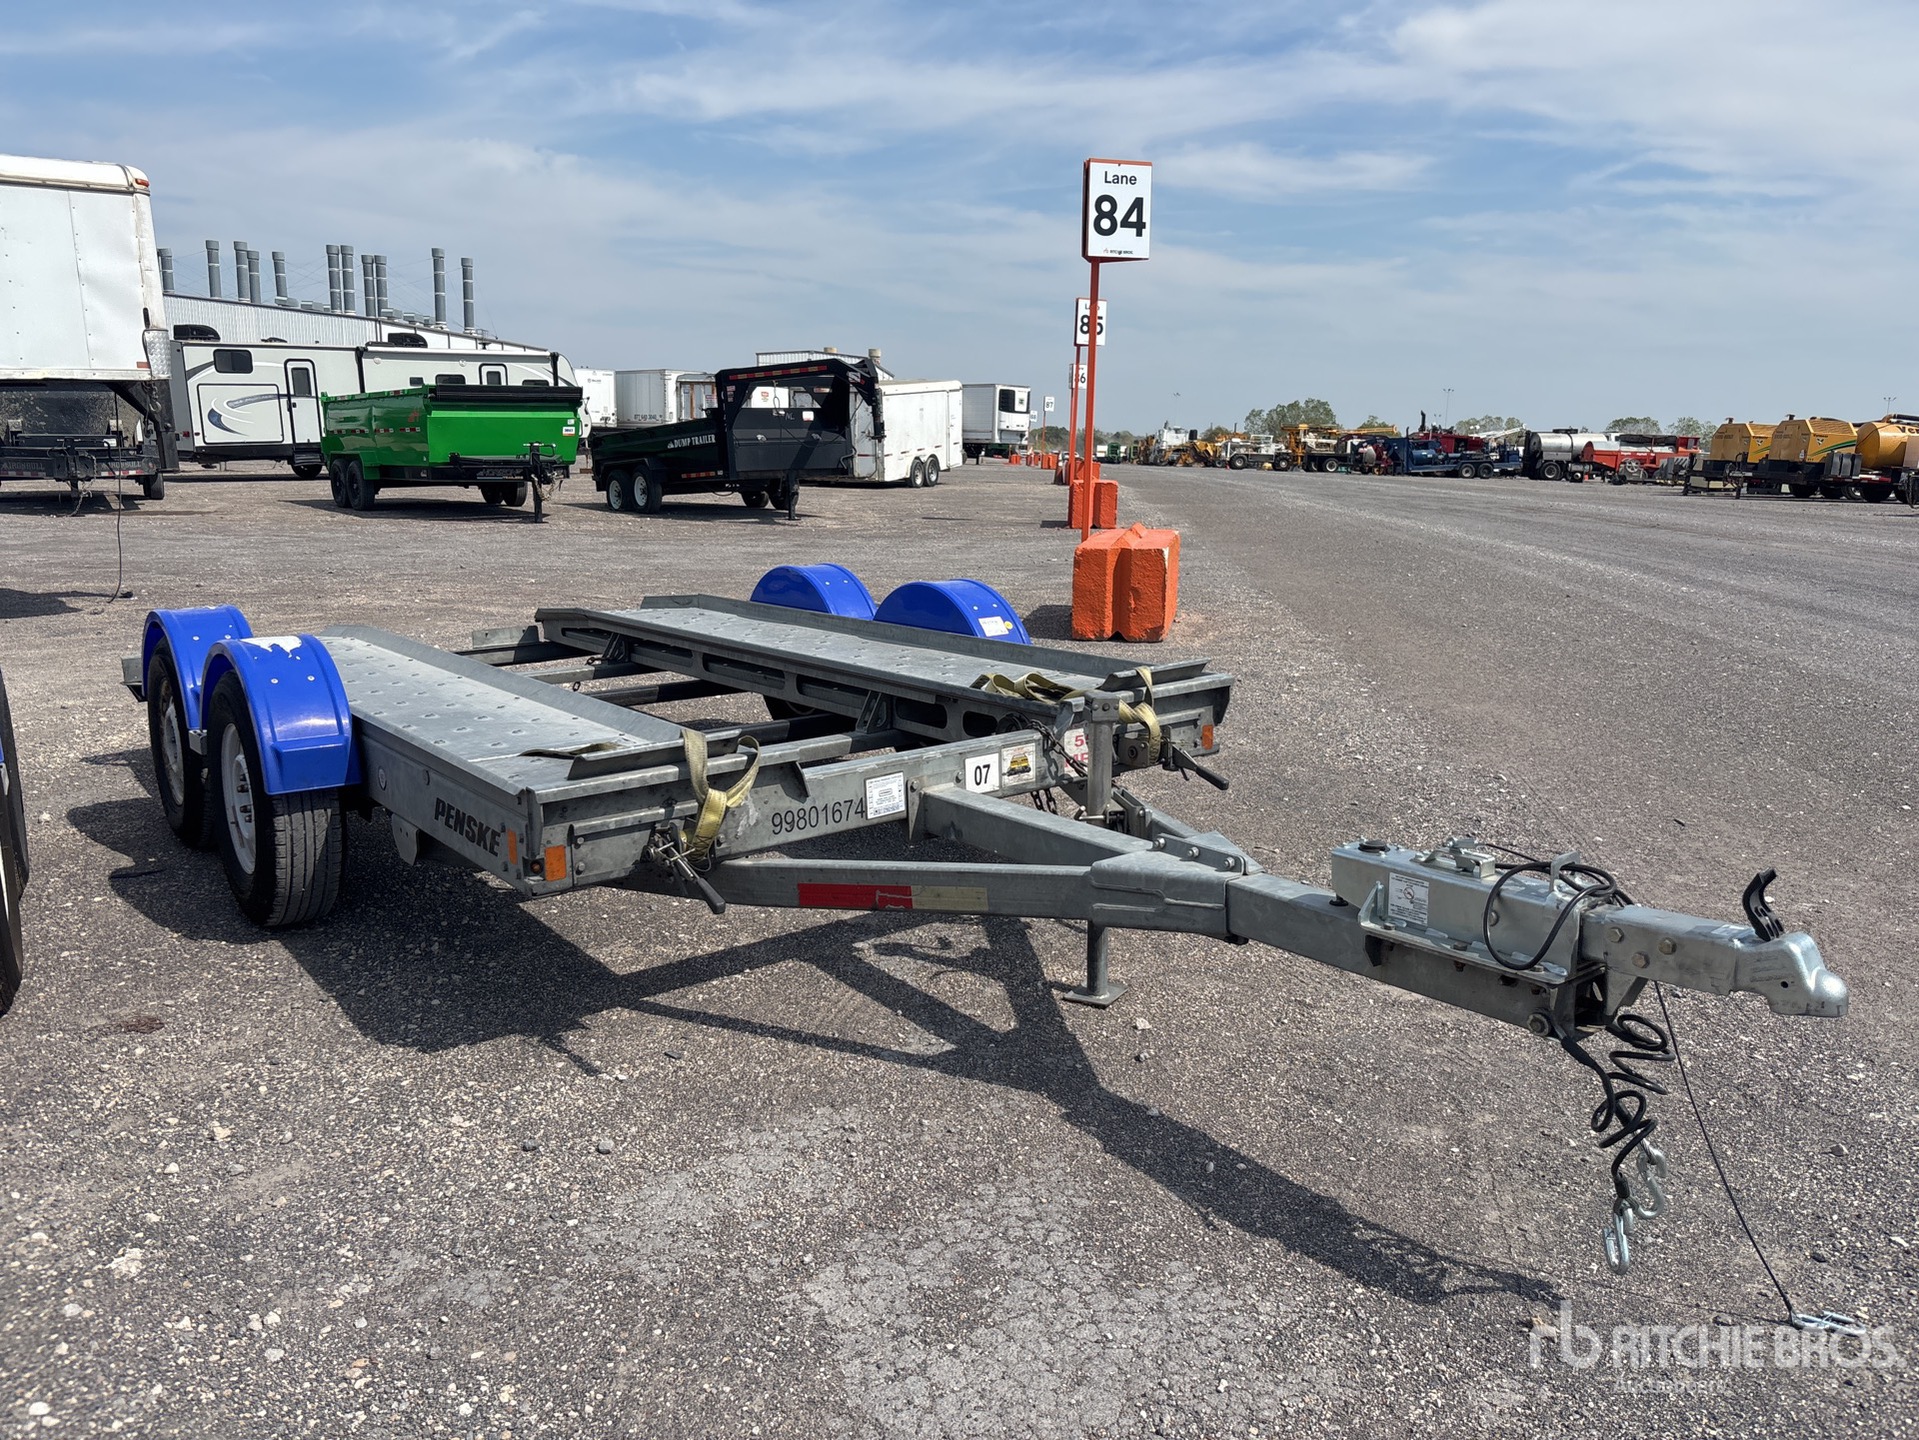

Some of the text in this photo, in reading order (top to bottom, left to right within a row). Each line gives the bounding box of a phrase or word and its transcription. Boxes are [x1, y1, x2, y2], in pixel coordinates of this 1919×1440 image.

[1104, 171, 1137, 185] Lane
[1093, 194, 1146, 237] 84
[674, 434, 716, 448] DUMP TRAILER
[974, 764, 991, 786] 07
[434, 797, 501, 857] PENSKE
[771, 797, 866, 835] 99801674
